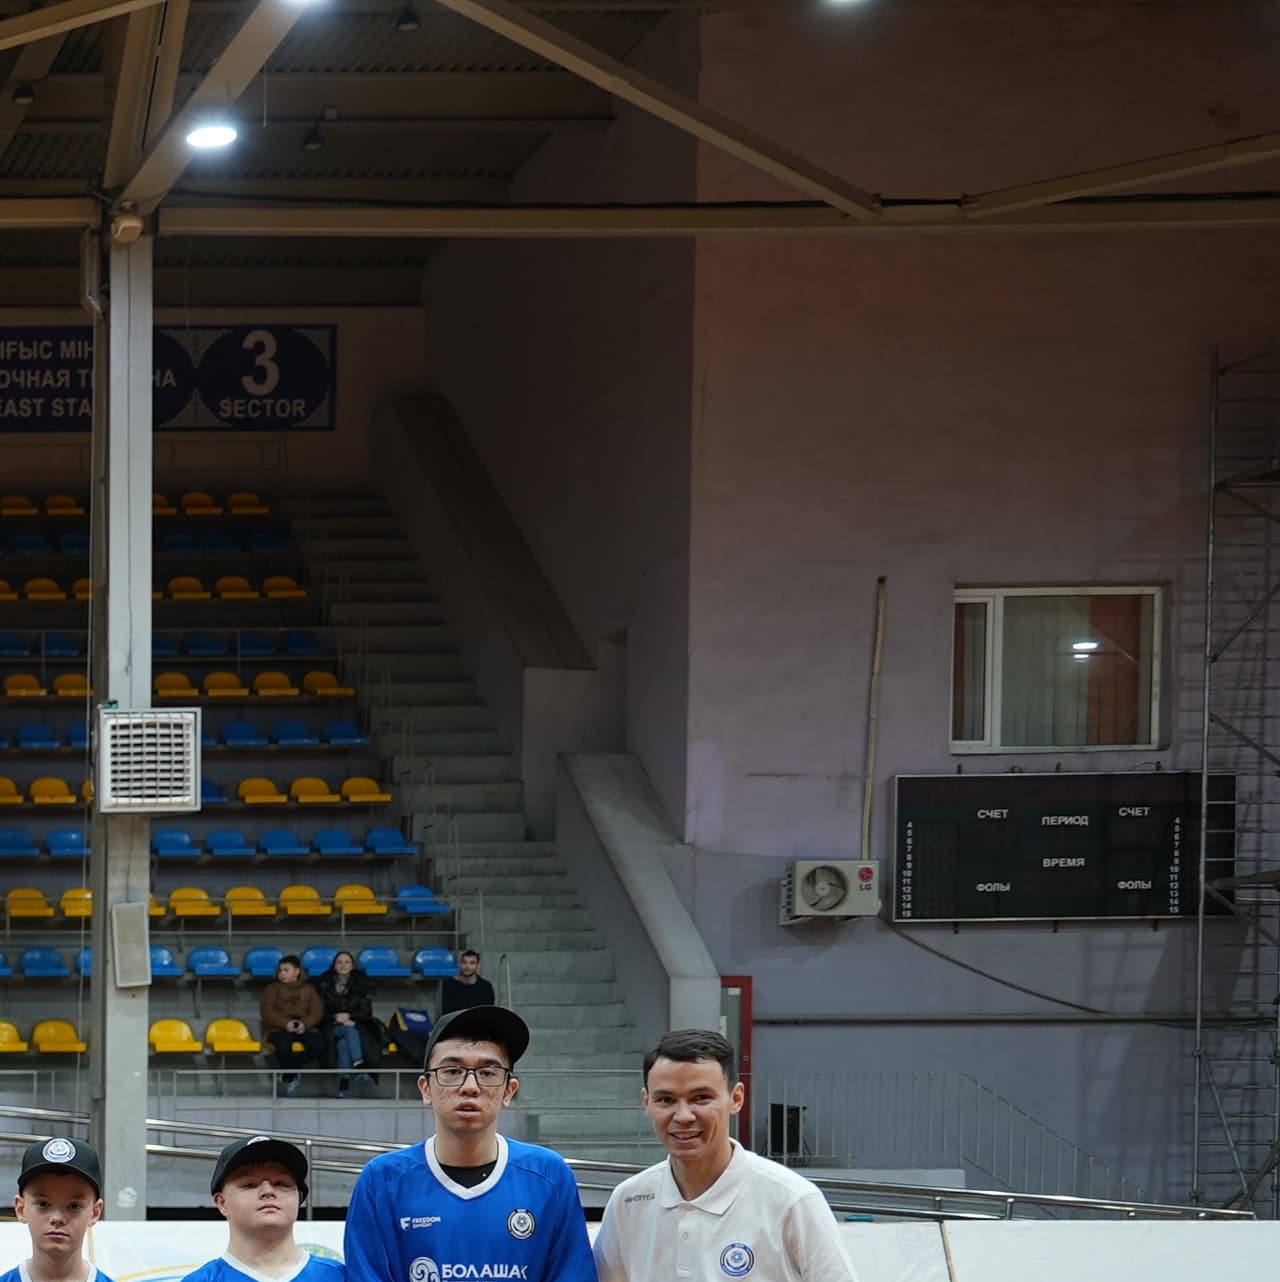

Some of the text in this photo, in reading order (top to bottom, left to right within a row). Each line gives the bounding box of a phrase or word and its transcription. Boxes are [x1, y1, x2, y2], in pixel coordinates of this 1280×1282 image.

[241, 330, 279, 395] 3
[51, 398, 93, 417] STA
[219, 398, 305, 417] SECTOR
[977, 808, 1009, 819] СЧЕТ
[1118, 806, 1150, 817] СЧЕТ
[1042, 815, 1089, 827] ПЕРИОД
[1043, 857, 1085, 868] ВРЕМЯ
[1169, 865, 1179, 873] 10
[1169, 873, 1178, 881] 11
[859, 884, 872, 892] LG
[976, 881, 1011, 893] ФОЛЫ
[1118, 879, 1152, 890] ФОЛЫ
[1169, 881, 1179, 889] 12
[1169, 906, 1179, 914] 15
[442, 1263, 528, 1280] БОЛАШАК
